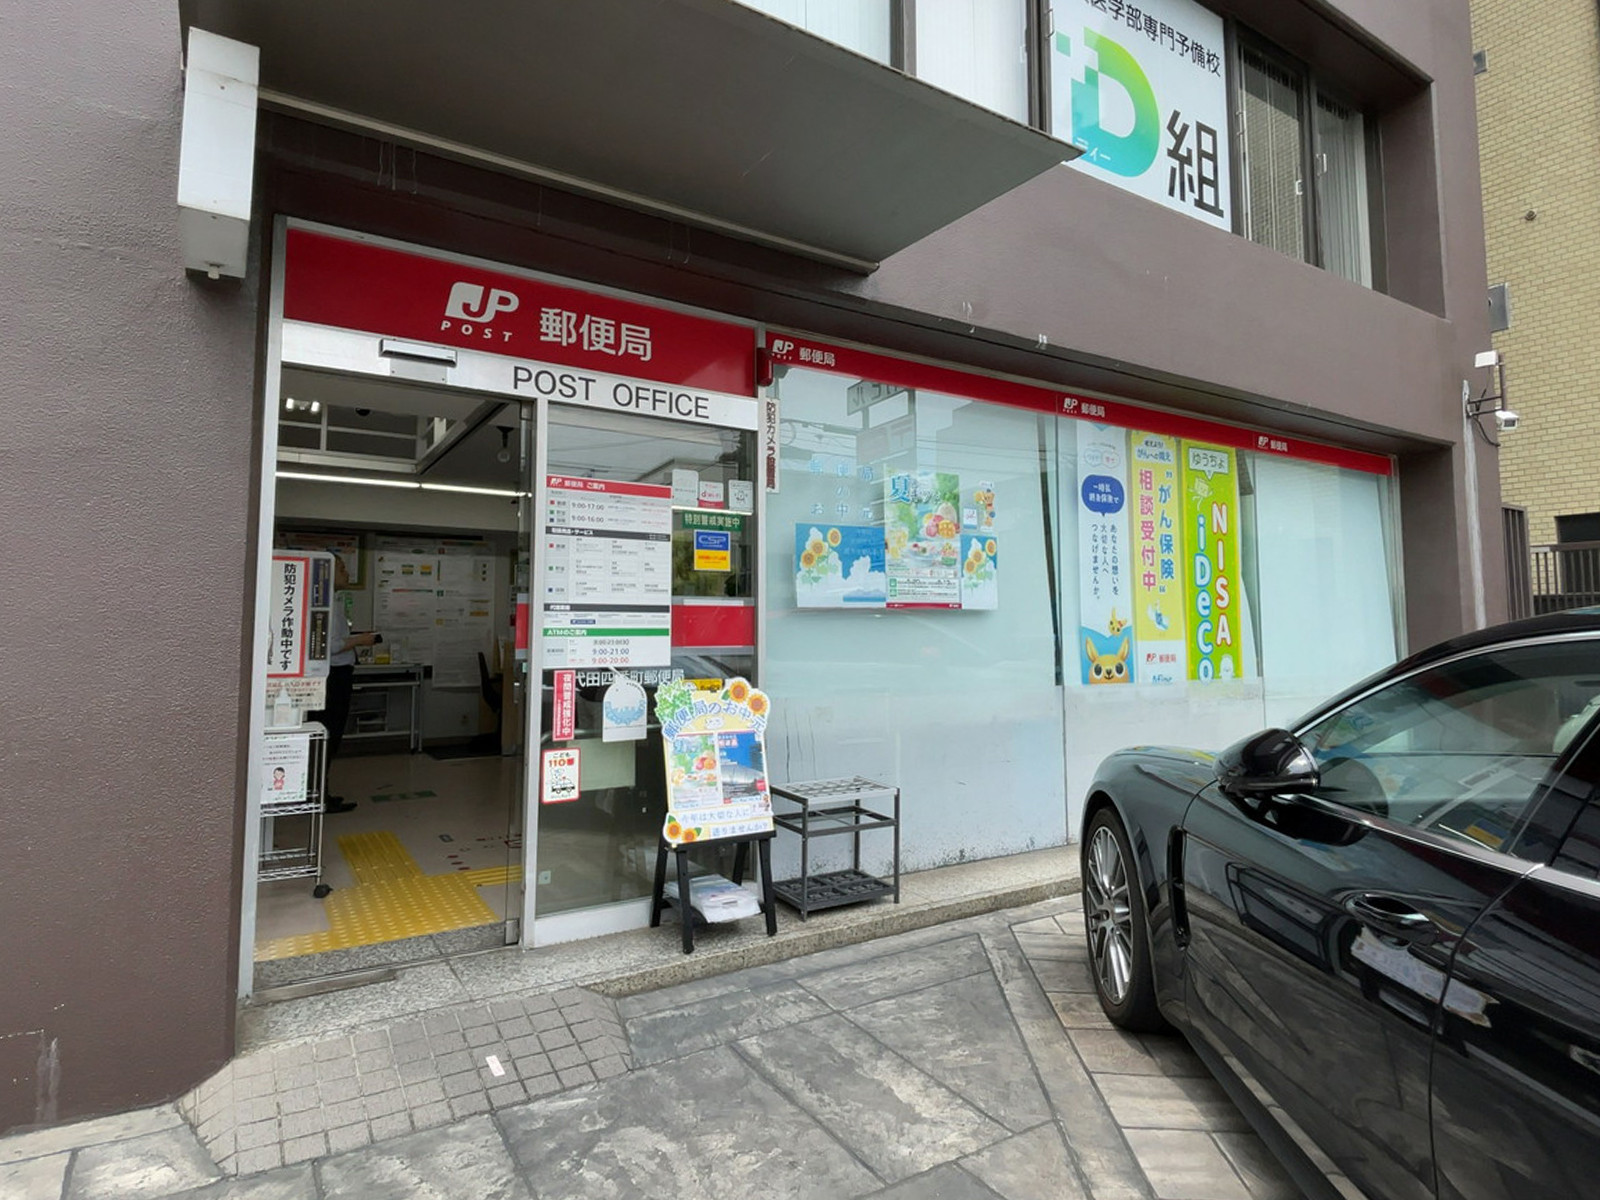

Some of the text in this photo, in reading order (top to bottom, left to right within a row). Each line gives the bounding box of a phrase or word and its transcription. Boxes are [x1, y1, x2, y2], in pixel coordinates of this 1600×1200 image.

[1084, 0, 1220, 77] 医学部専門予備校
[445, 281, 519, 323] JP
[441, 320, 513, 342] POST
[540, 307, 652, 362] 郵便局
[799, 347, 835, 367] 郵便局
[513, 366, 709, 419] POST OFFICE
[1081, 402, 1106, 418] 郵便局
[1193, 451, 1225, 469] ゆうちょ
[684, 512, 740, 529] 特別警戒実施中
[698, 535, 727, 545] CSP
[1139, 469, 1156, 592] 相談受付中
[1100, 524, 1109, 574] 大切な人へ
[1110, 524, 1119, 596] あなたの想いを
[1211, 501, 1232, 647] NISA
[279, 563, 297, 671] 防犯カメラ作動中です
[1194, 514, 1214, 684] iDeCo
[663, 700, 766, 741] 郵便局のお中元
